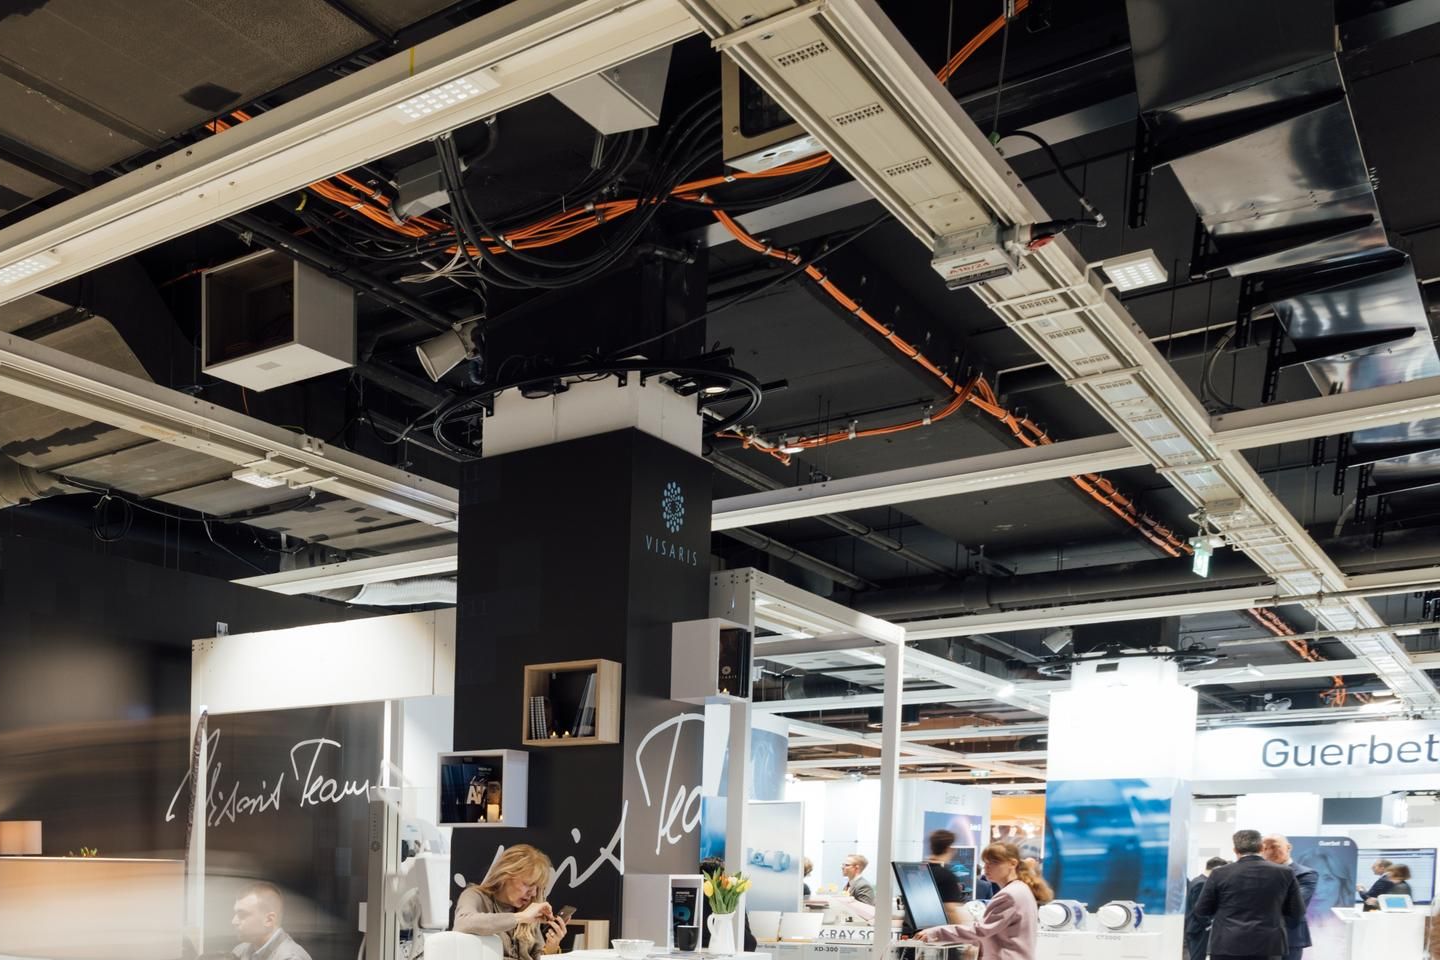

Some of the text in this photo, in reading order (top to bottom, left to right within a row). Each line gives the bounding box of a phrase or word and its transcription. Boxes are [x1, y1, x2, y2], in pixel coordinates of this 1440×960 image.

[645, 534, 697, 567] VISARIS
[1262, 733, 1440, 768] Guerbet
[290, 737, 371, 808] Team
[818, 929, 855, 939] X-RAY
